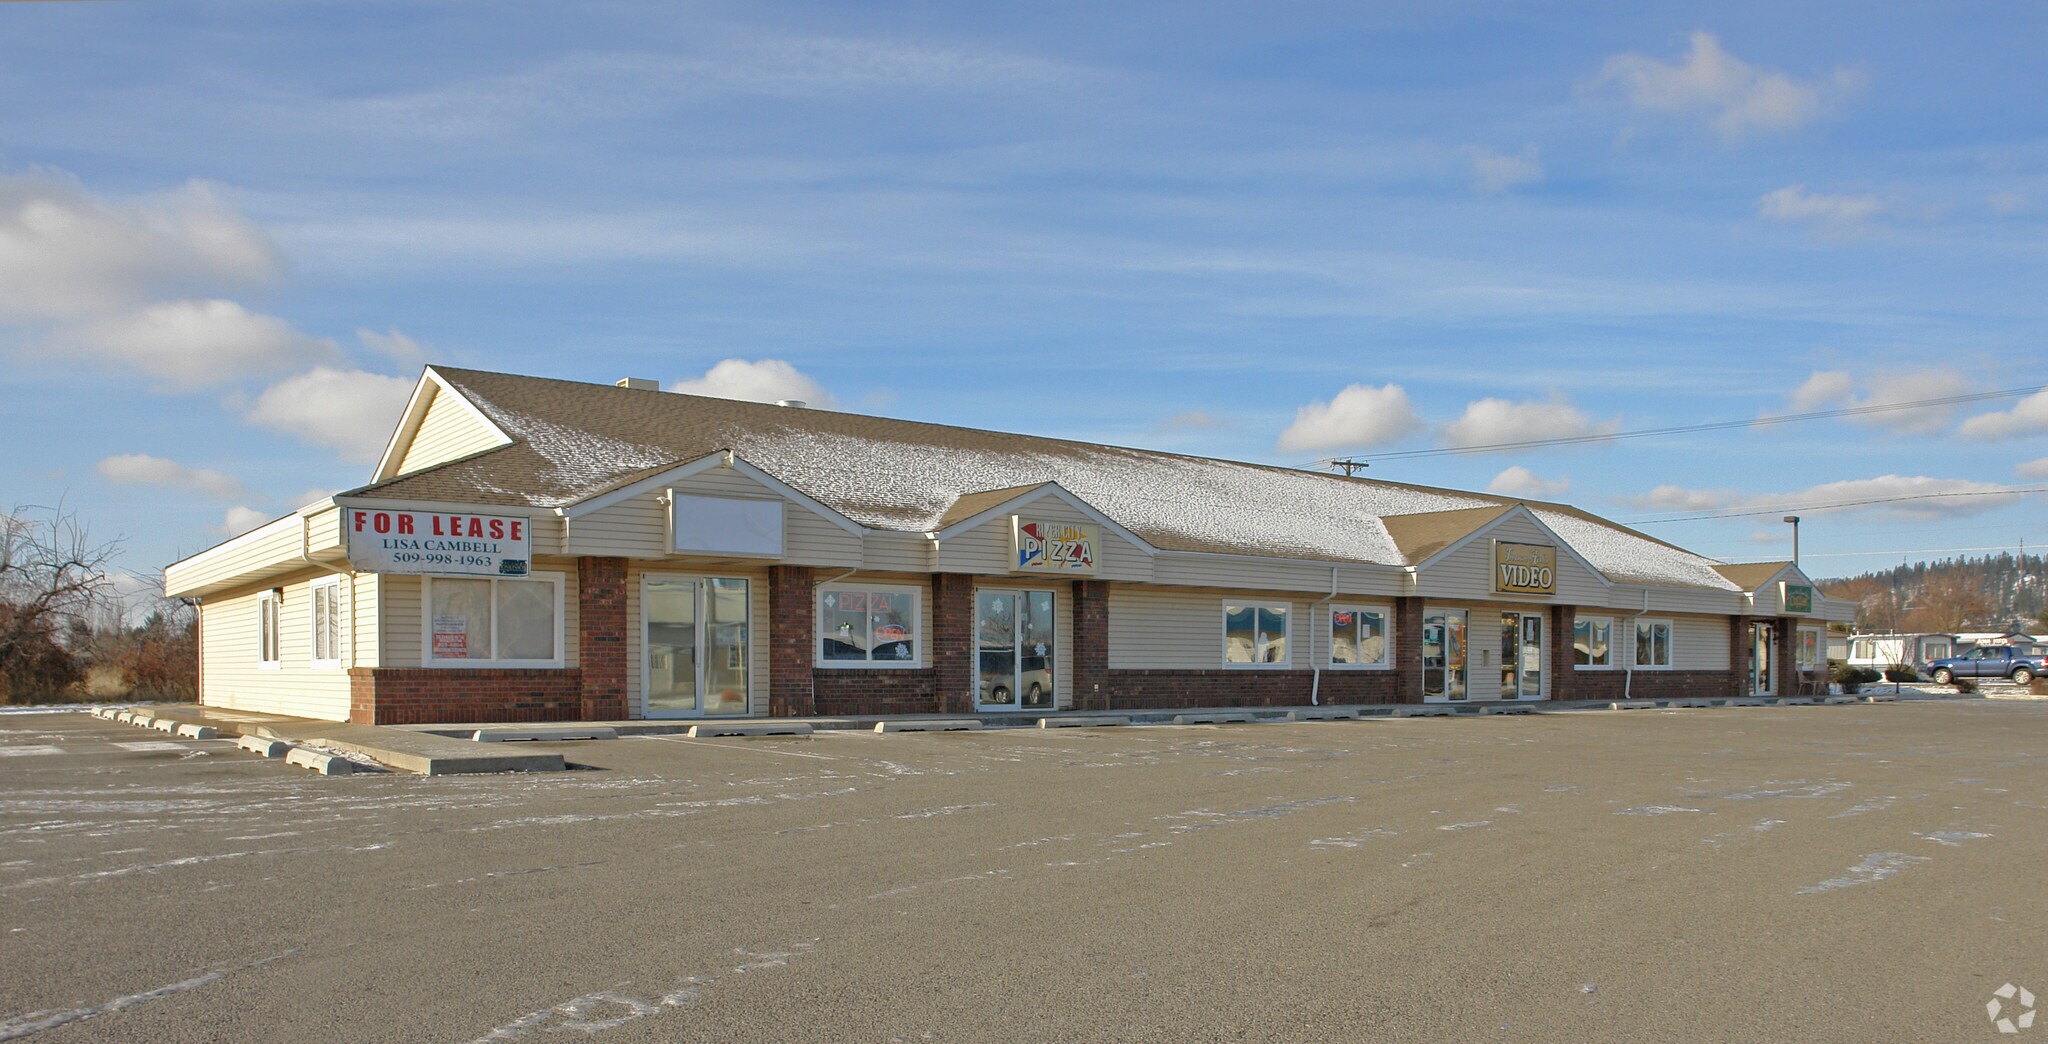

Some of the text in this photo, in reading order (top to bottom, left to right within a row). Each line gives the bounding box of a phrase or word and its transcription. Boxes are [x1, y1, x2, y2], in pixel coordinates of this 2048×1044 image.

[354, 511, 522, 541] FOR LEASE
[383, 538, 502, 554] LISA CAMBELL
[1025, 537, 1093, 563] PIZZA
[393, 552, 492, 567] 509-998-1963
[1500, 563, 1553, 589] VIDEO
[839, 594, 889, 611] PIZZA
[1334, 613, 1352, 623] OPEN
[876, 626, 905, 640] OPEN
